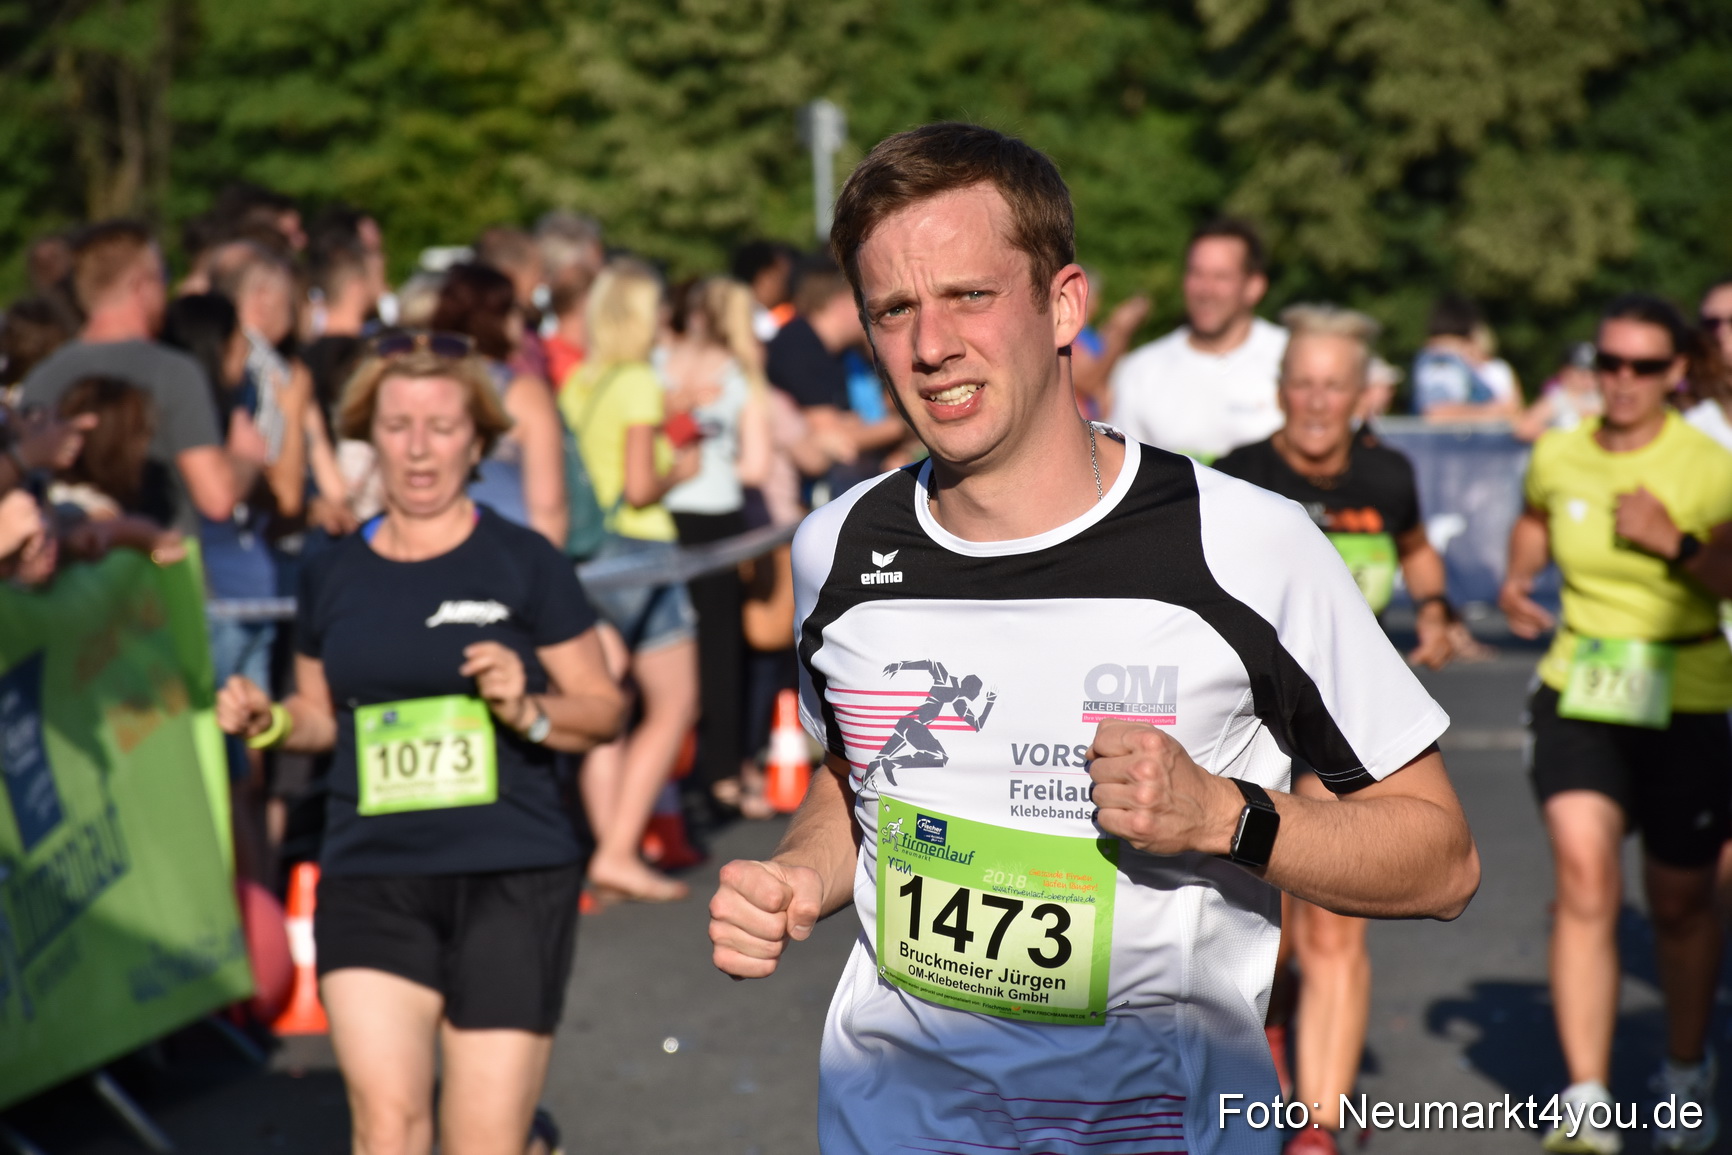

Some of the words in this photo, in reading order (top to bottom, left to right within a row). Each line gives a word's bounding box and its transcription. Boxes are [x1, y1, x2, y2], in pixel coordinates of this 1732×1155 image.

[860, 570, 903, 585] erima
[1084, 663, 1179, 703] OM
[1084, 702, 1121, 712] KLEBE
[1124, 703, 1176, 713] TECHNIK
[377, 738, 474, 780] 1073
[902, 832, 976, 866] firmenlauf
[902, 849, 932, 862] neumarkt
[982, 868, 1028, 889] 2018
[899, 875, 1073, 969] 1473
[899, 941, 993, 980] Bruckmeier
[998, 968, 1066, 992] Jürgen
[908, 965, 1004, 998] OM-Klebetechnik
[1008, 988, 1049, 1004] GmbH
